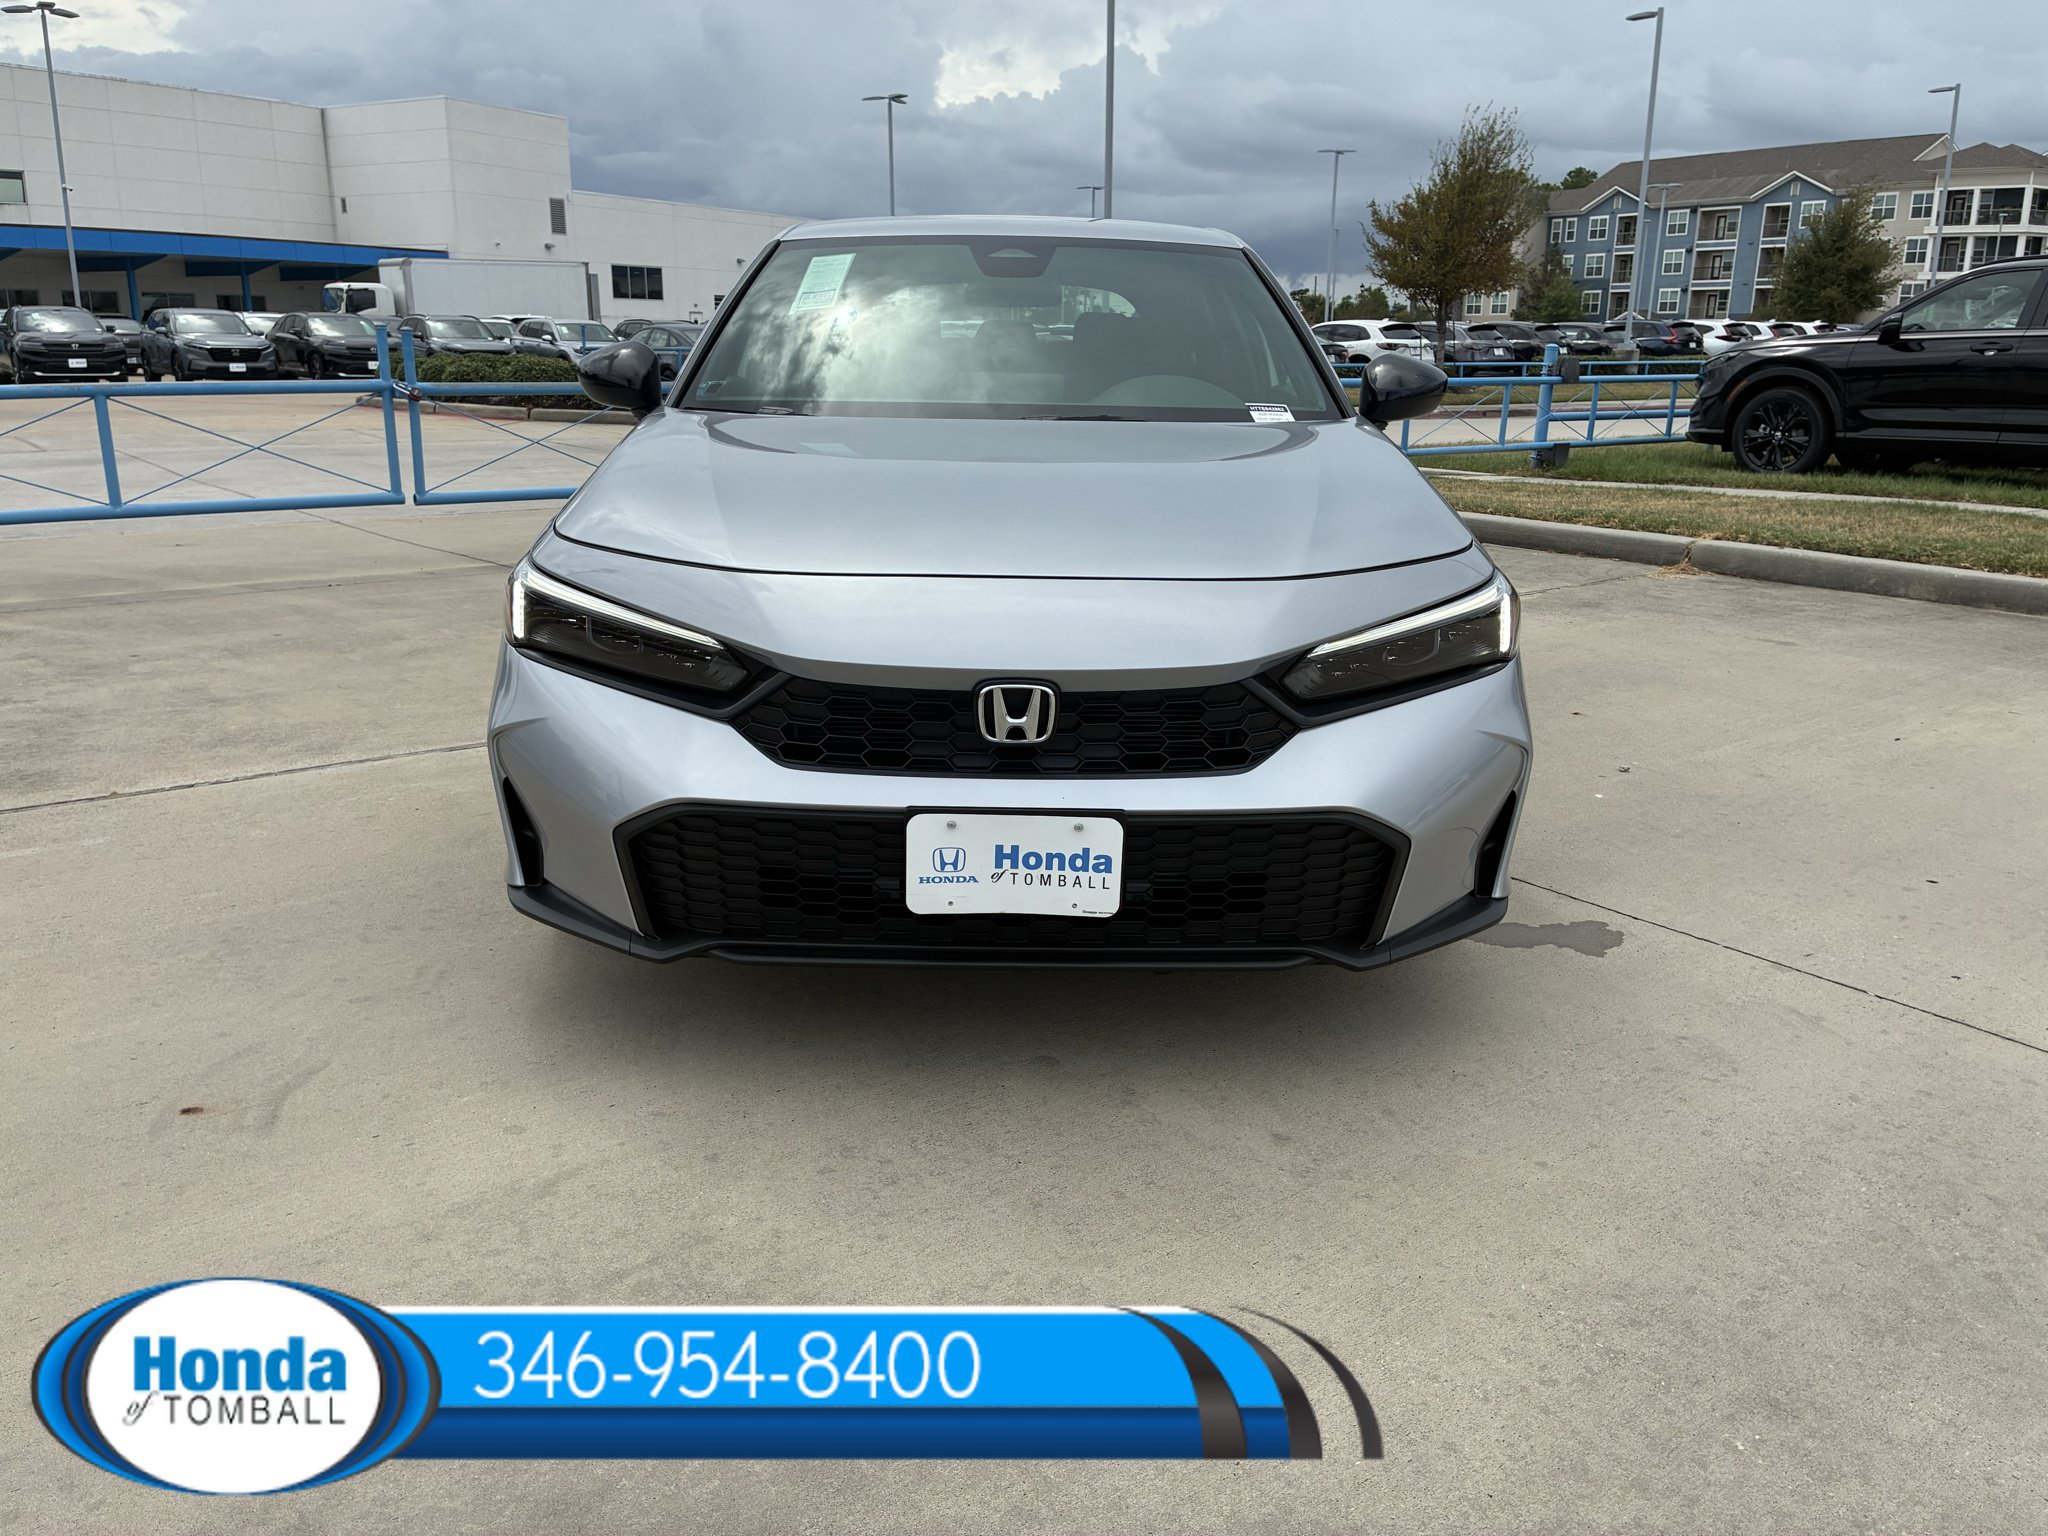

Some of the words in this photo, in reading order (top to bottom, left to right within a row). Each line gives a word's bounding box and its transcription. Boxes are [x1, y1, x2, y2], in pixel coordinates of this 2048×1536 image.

[994, 844, 1113, 874] Honda
[918, 875, 979, 884] HONDA
[990, 868, 1009, 883] of
[1009, 872, 1111, 890] TOMBALL
